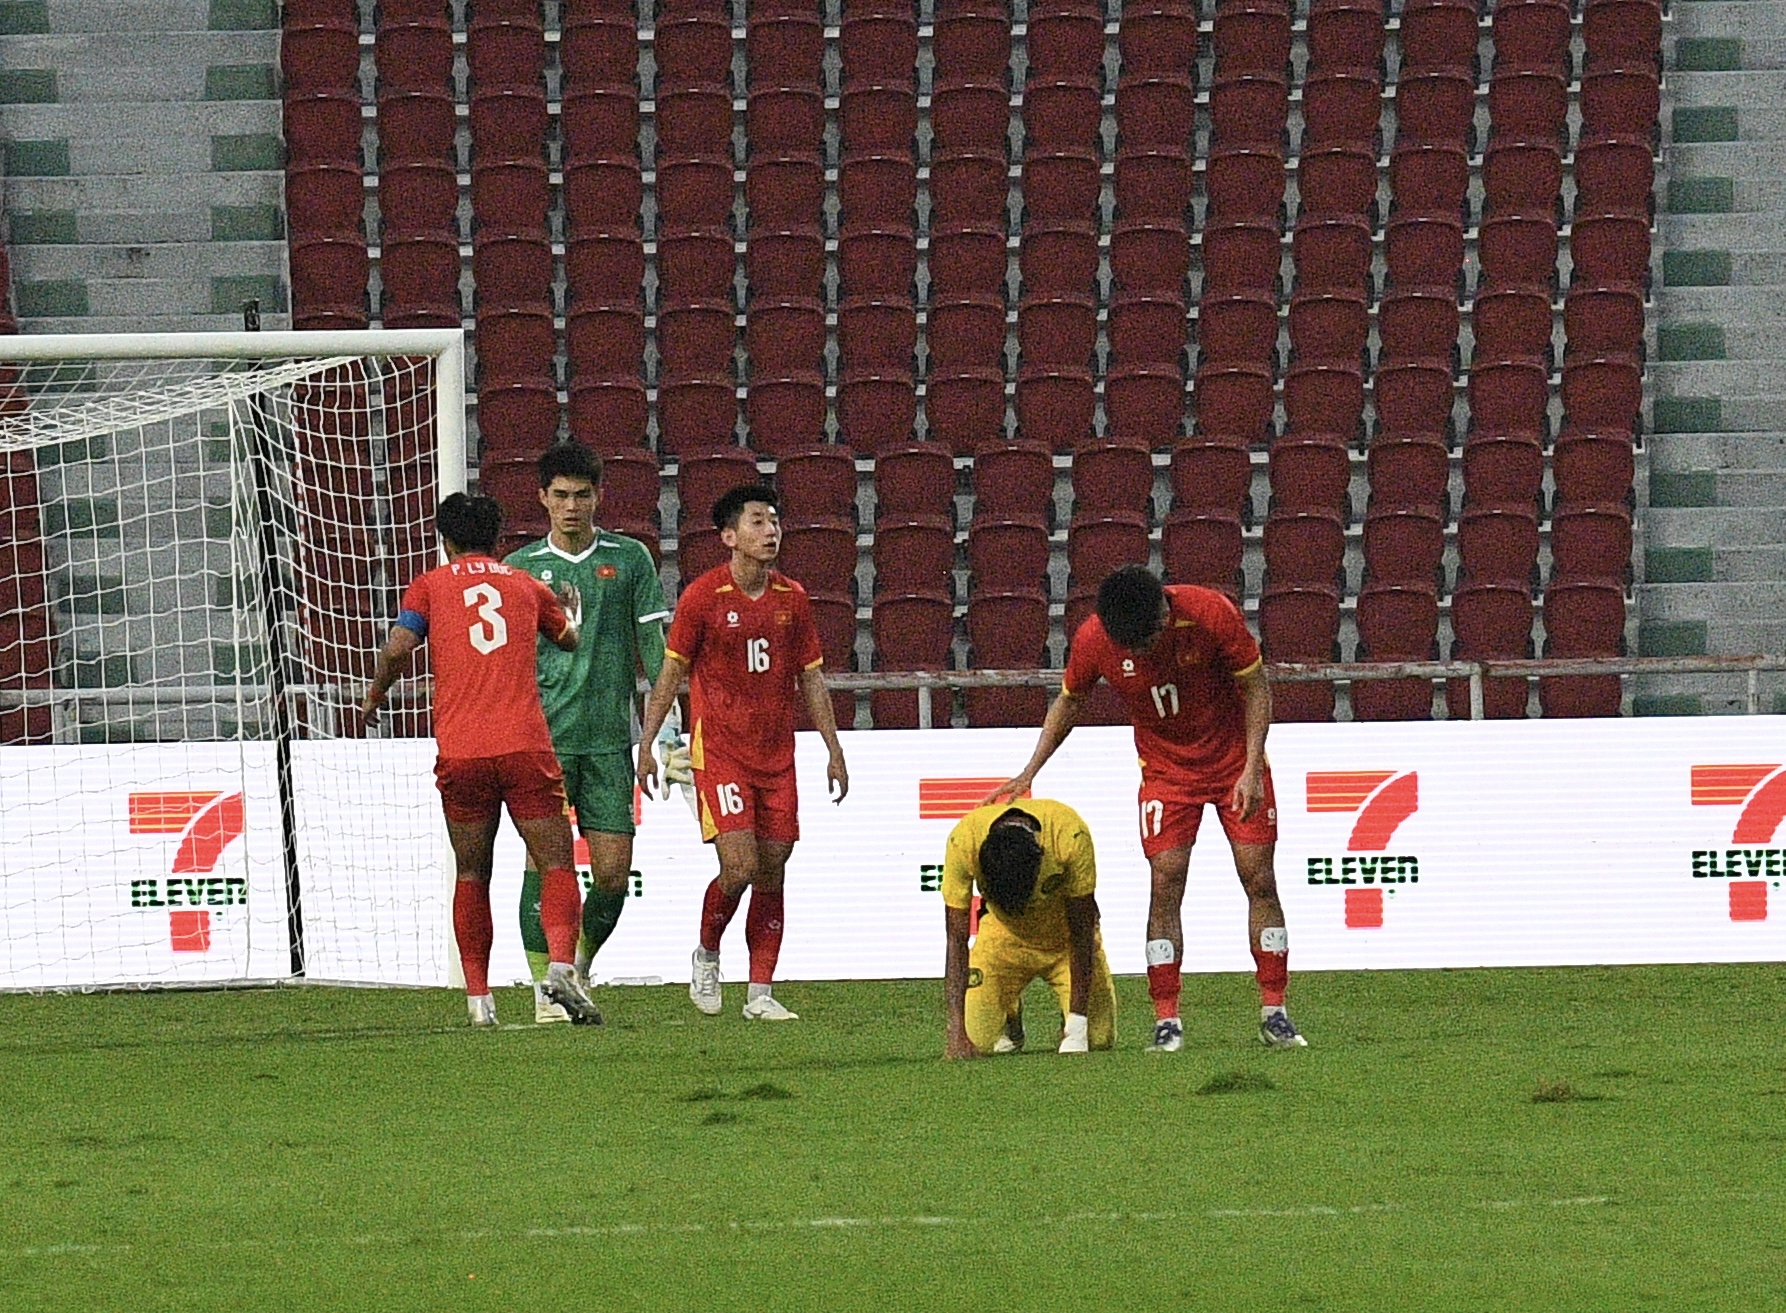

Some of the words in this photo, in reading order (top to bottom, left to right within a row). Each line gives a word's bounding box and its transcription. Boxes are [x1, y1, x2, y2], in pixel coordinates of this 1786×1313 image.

[451, 563, 466, 576] P.
[463, 582, 508, 655] 3
[747, 637, 770, 673] 16
[1150, 683, 1180, 719] 17
[716, 782, 744, 817] 16
[1141, 799, 1164, 839] 17
[1306, 771, 1419, 928] 7
[1691, 849, 1786, 879] ELEVE
[128, 791, 246, 953] 7
